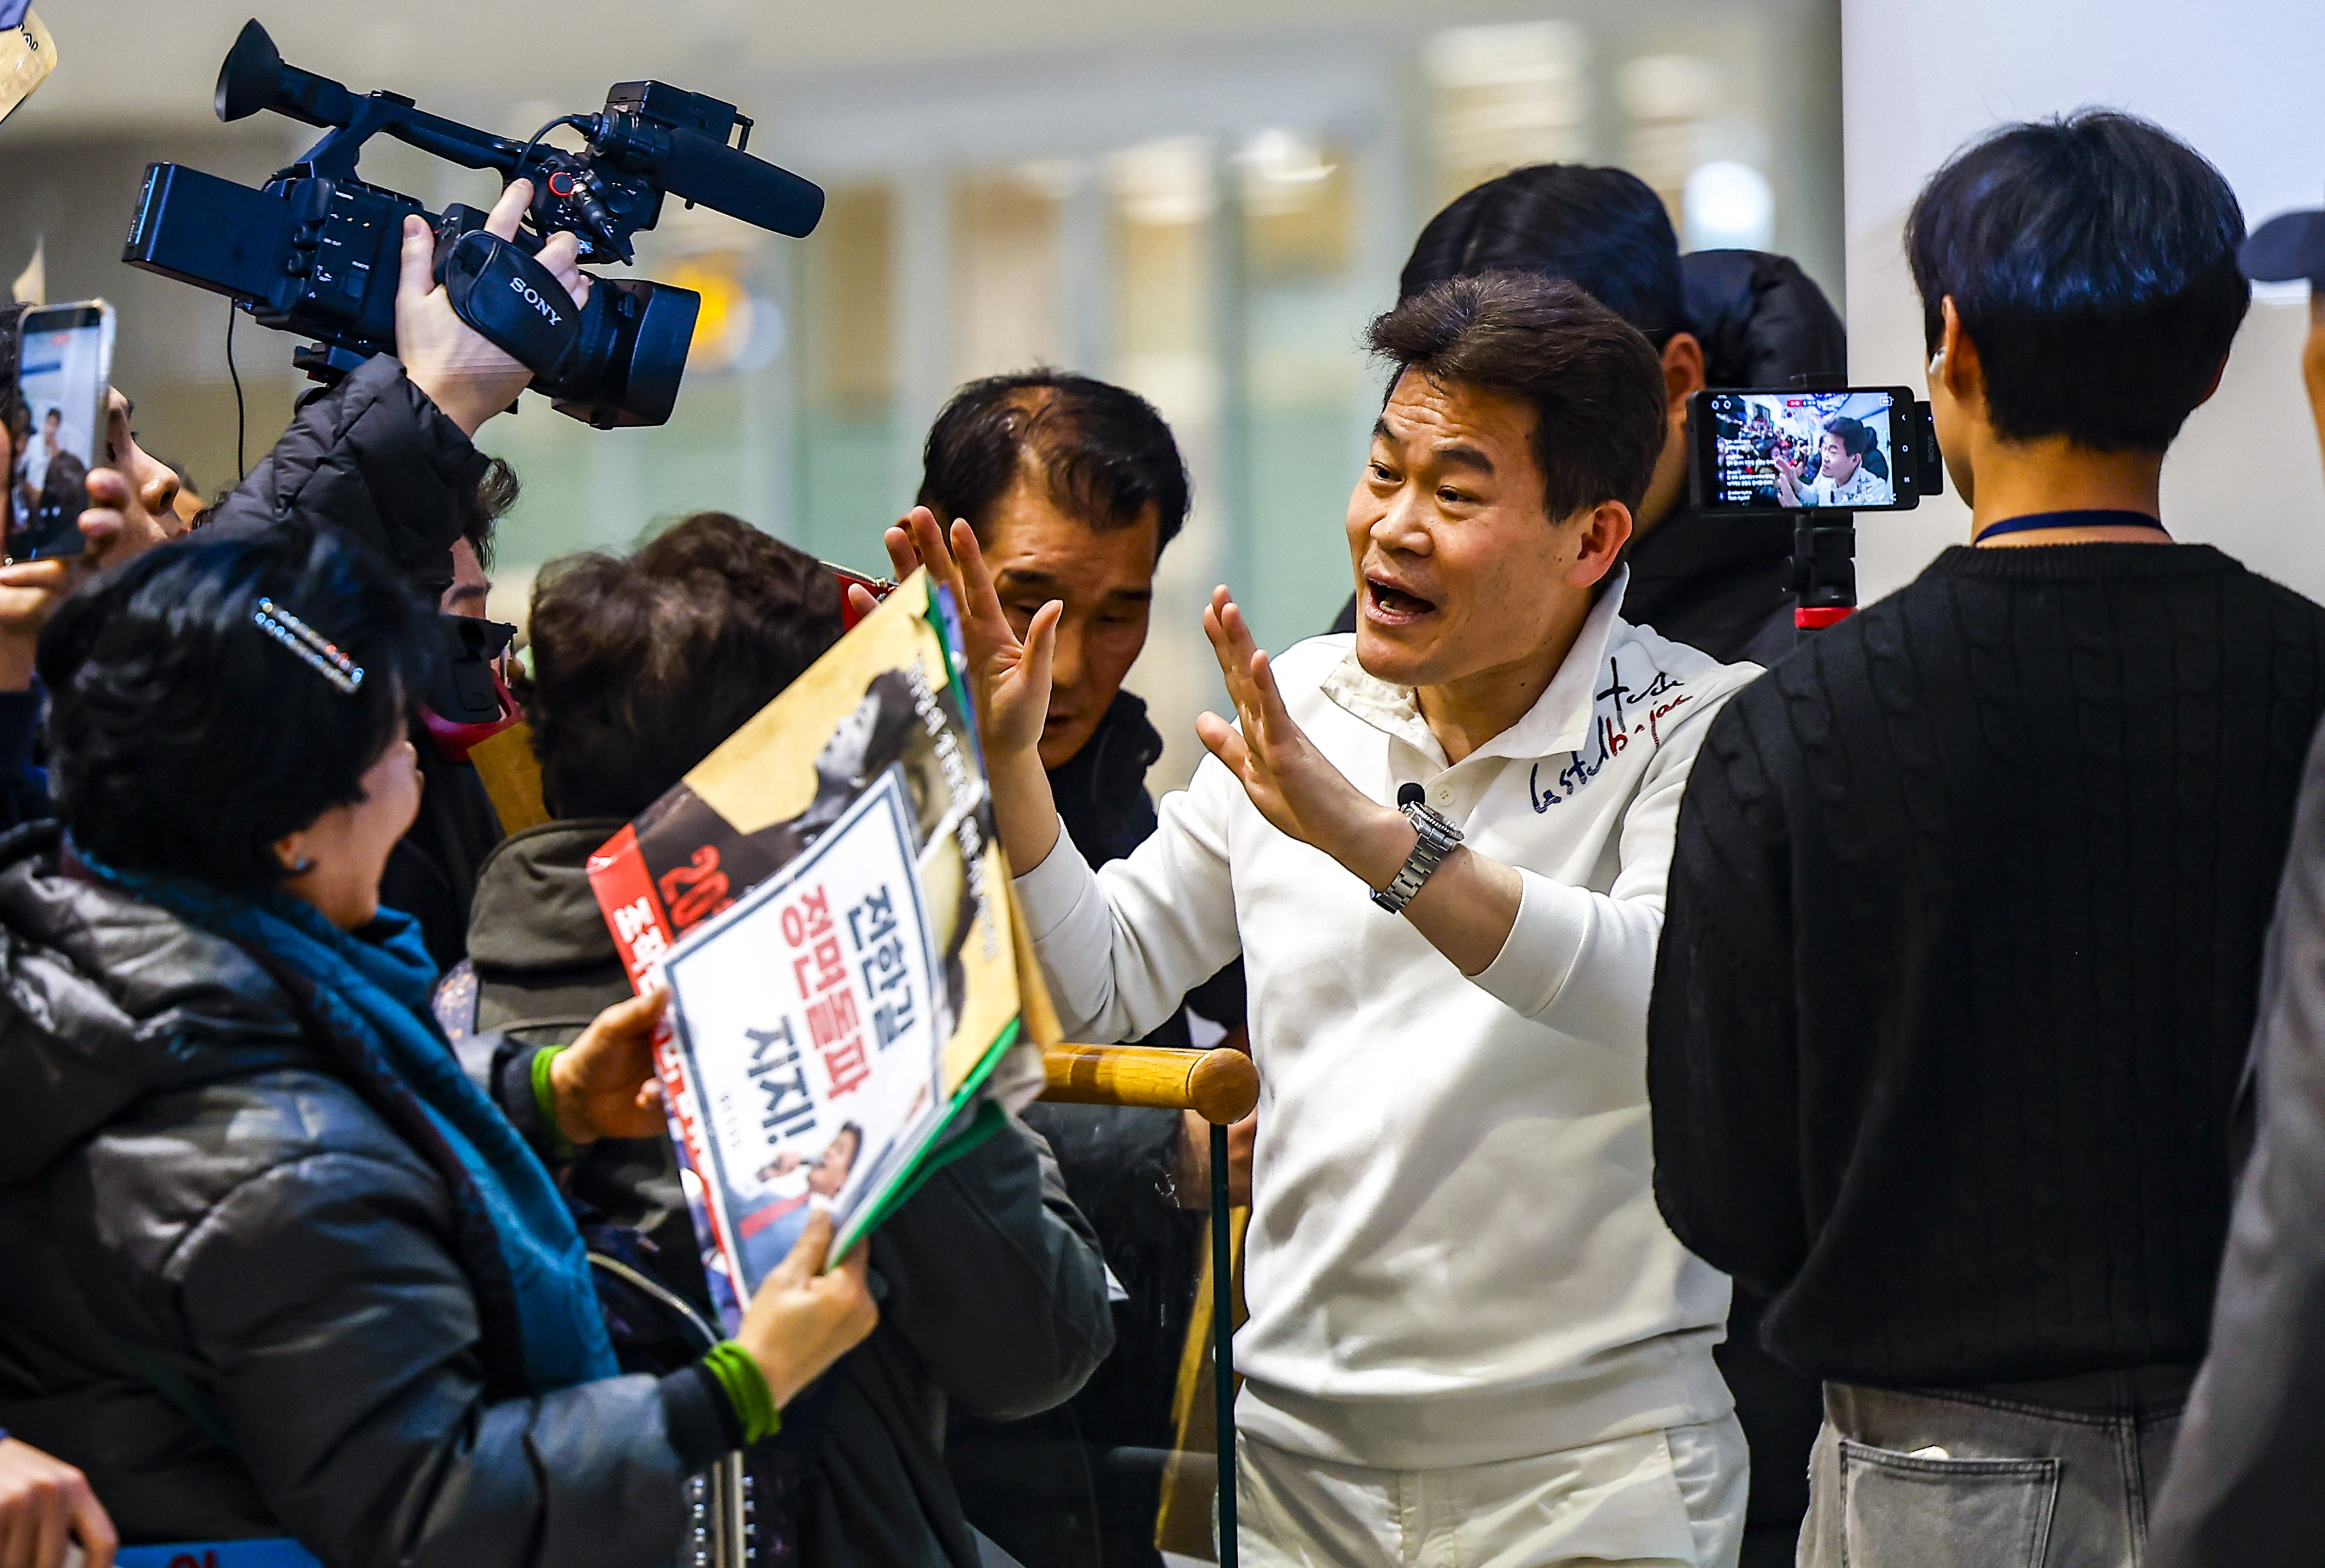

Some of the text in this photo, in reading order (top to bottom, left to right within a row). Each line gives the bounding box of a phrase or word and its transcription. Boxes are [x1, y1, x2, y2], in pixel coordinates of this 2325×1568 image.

[510, 277, 562, 326] SONY
[781, 884, 871, 1101] 정면돌파
[847, 885, 914, 1052] 전한길
[745, 1015, 818, 1146] 지지!
